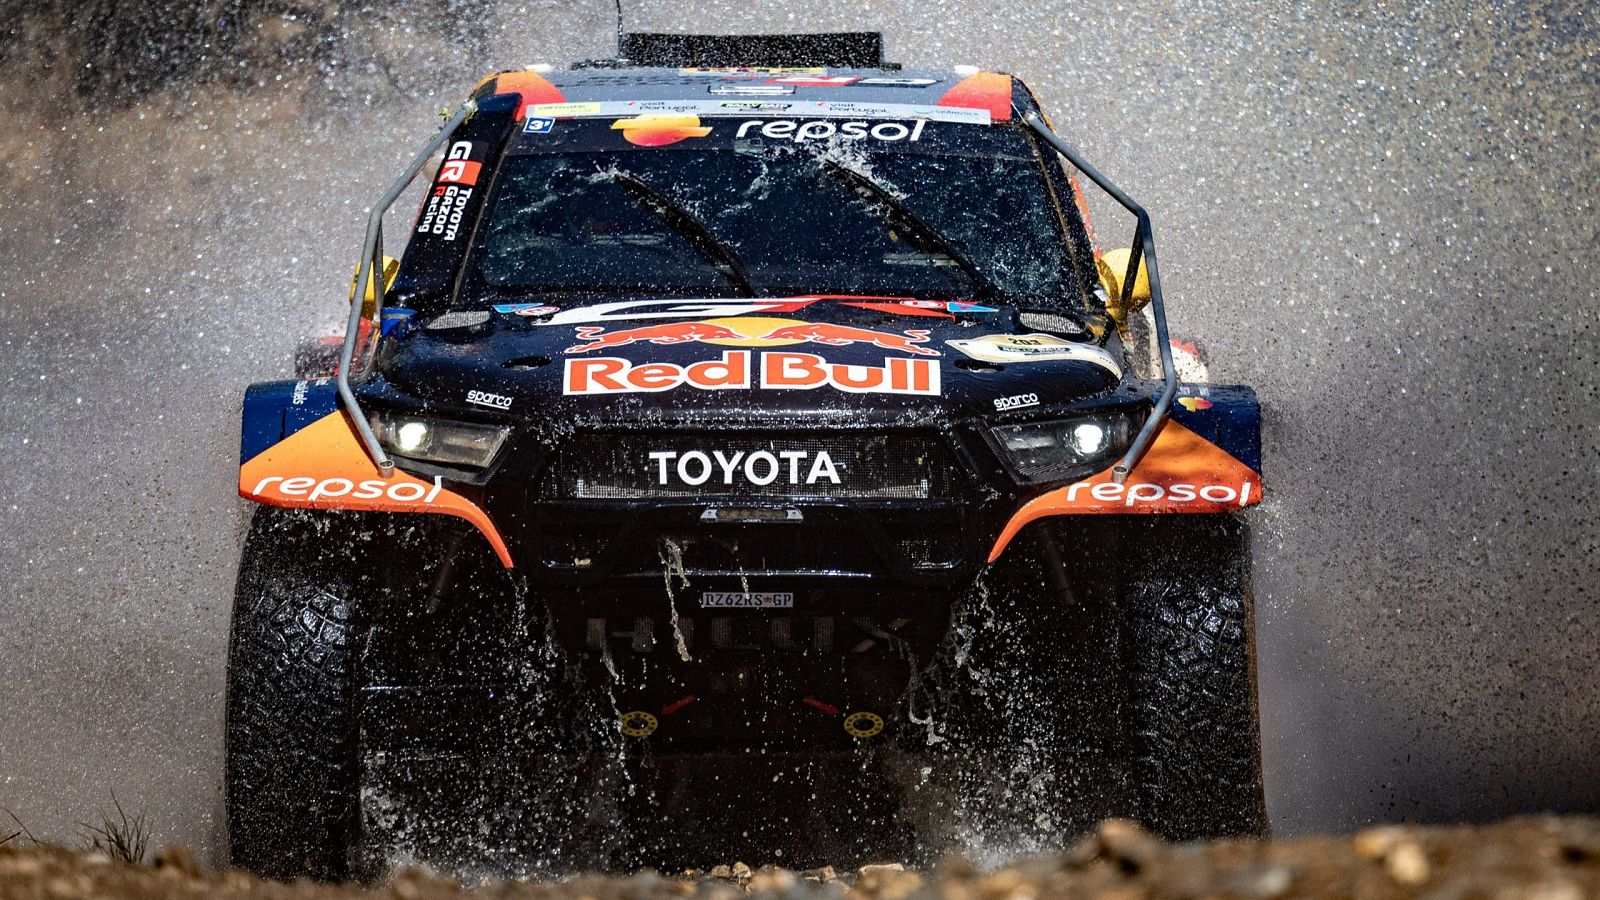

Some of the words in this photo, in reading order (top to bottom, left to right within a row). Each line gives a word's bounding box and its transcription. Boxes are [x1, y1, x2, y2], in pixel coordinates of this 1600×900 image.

[735, 118, 926, 143] repsol
[438, 141, 473, 182] GR
[418, 186, 447, 233] Racing
[433, 186, 459, 234] GAZOO
[444, 188, 473, 241] TOYOTA
[566, 351, 747, 394] Red
[763, 353, 933, 393] Bull
[467, 390, 513, 408] sparco
[994, 391, 1039, 410] sparco
[649, 451, 842, 486] TOYOTA
[252, 475, 443, 504] repsol
[1065, 481, 1251, 507] repsol
